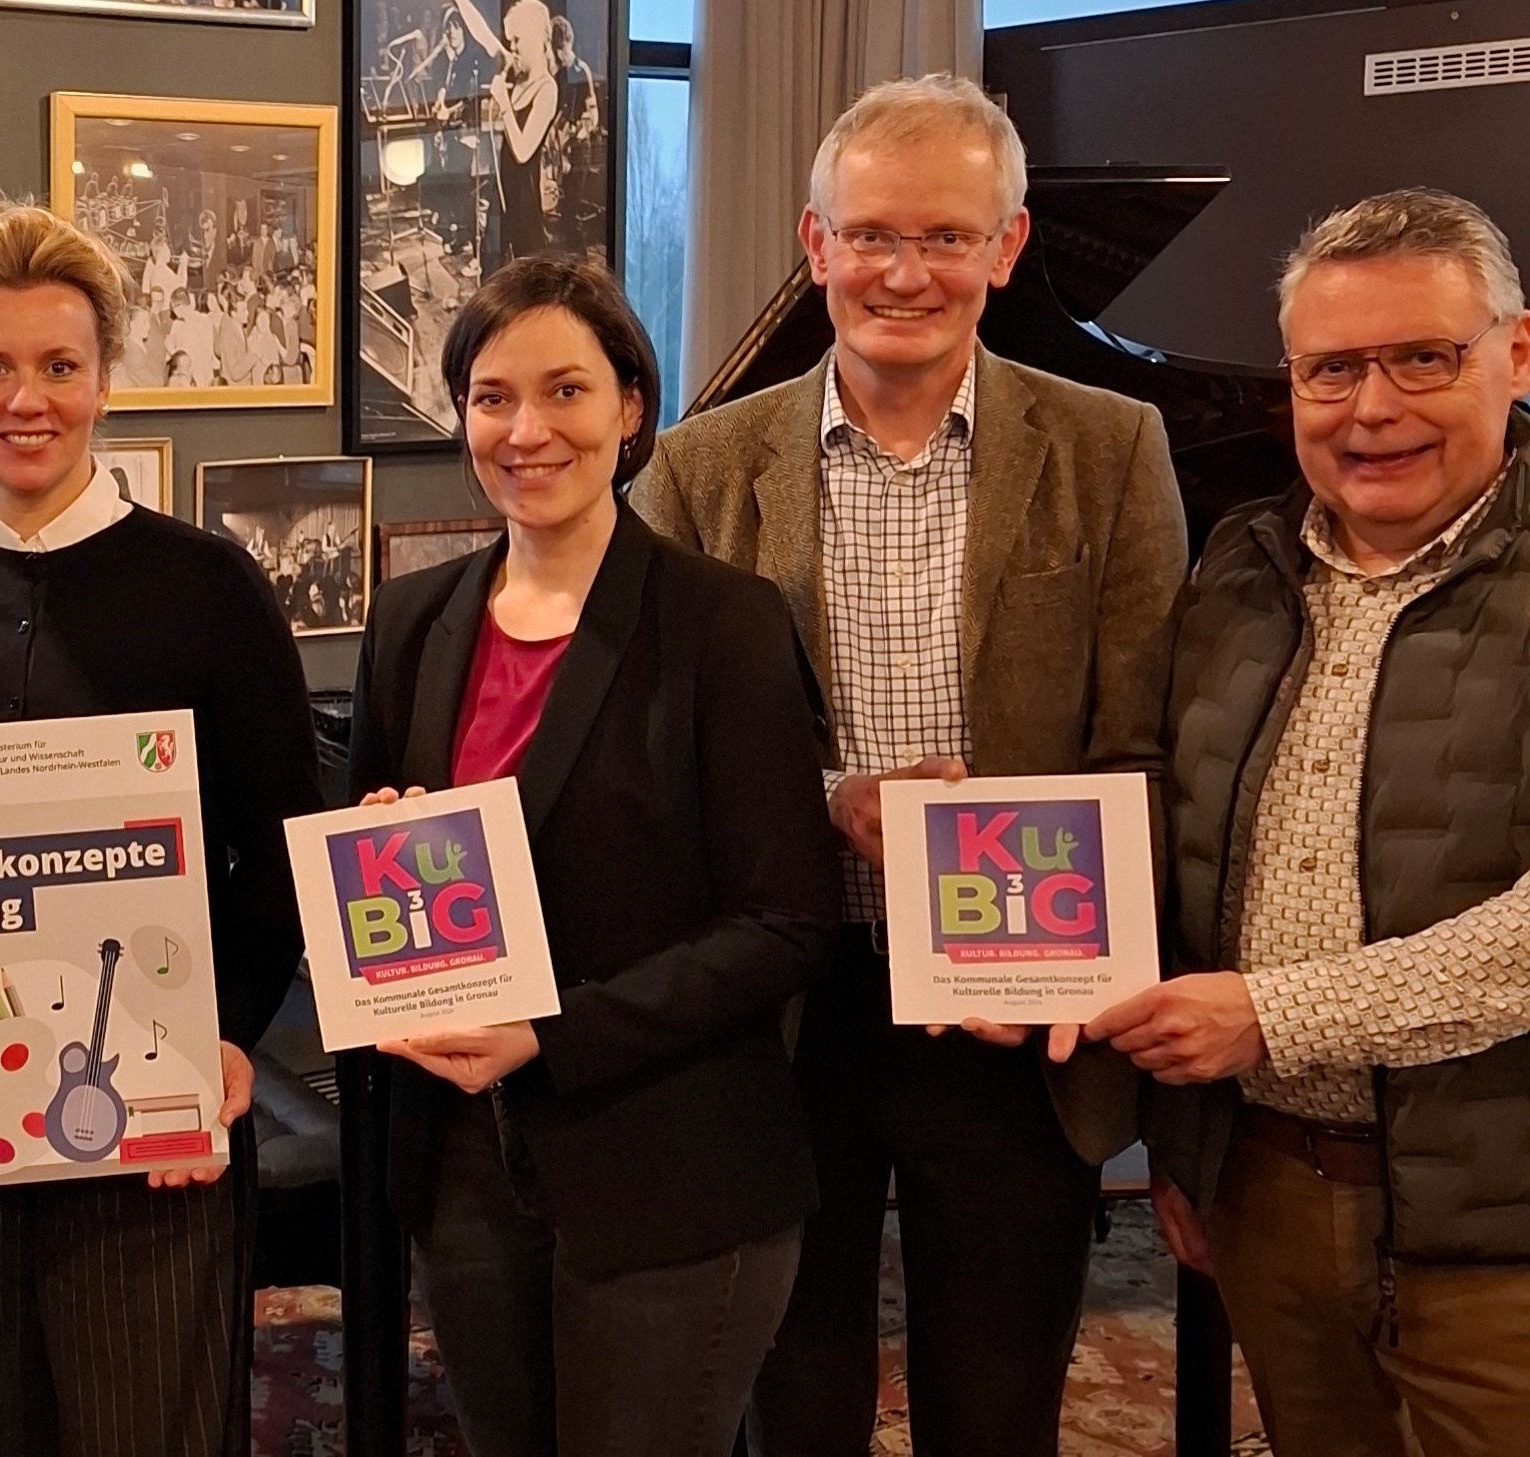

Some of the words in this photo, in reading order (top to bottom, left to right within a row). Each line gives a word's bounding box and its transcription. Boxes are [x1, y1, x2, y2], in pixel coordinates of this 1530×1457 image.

[35, 740, 46, 748] für
[11, 753, 26, 762] und
[29, 749, 85, 761] Wissenschaft
[0, 764, 30, 775] Landes
[33, 758, 121, 773] Nordrhein-Westfalen
[954, 975, 1012, 983] Kommunale
[1016, 975, 1094, 985] Gesamtkonzept
[1098, 974, 1112, 982] für
[355, 999, 371, 1007] Das
[373, 989, 426, 1004] Kommunale
[428, 978, 497, 994] Gesamtkonzept
[500, 974, 513, 984] für
[953, 987, 1001, 996] Kulturelle
[1004, 987, 1042, 997] Bildung
[1045, 987, 1054, 995] in
[1058, 987, 1094, 995] Gronau
[373, 1002, 417, 1016] Kulturelle
[420, 997, 453, 1008] Bildung
[455, 994, 464, 1002] in
[466, 989, 498, 1001] Gronau
